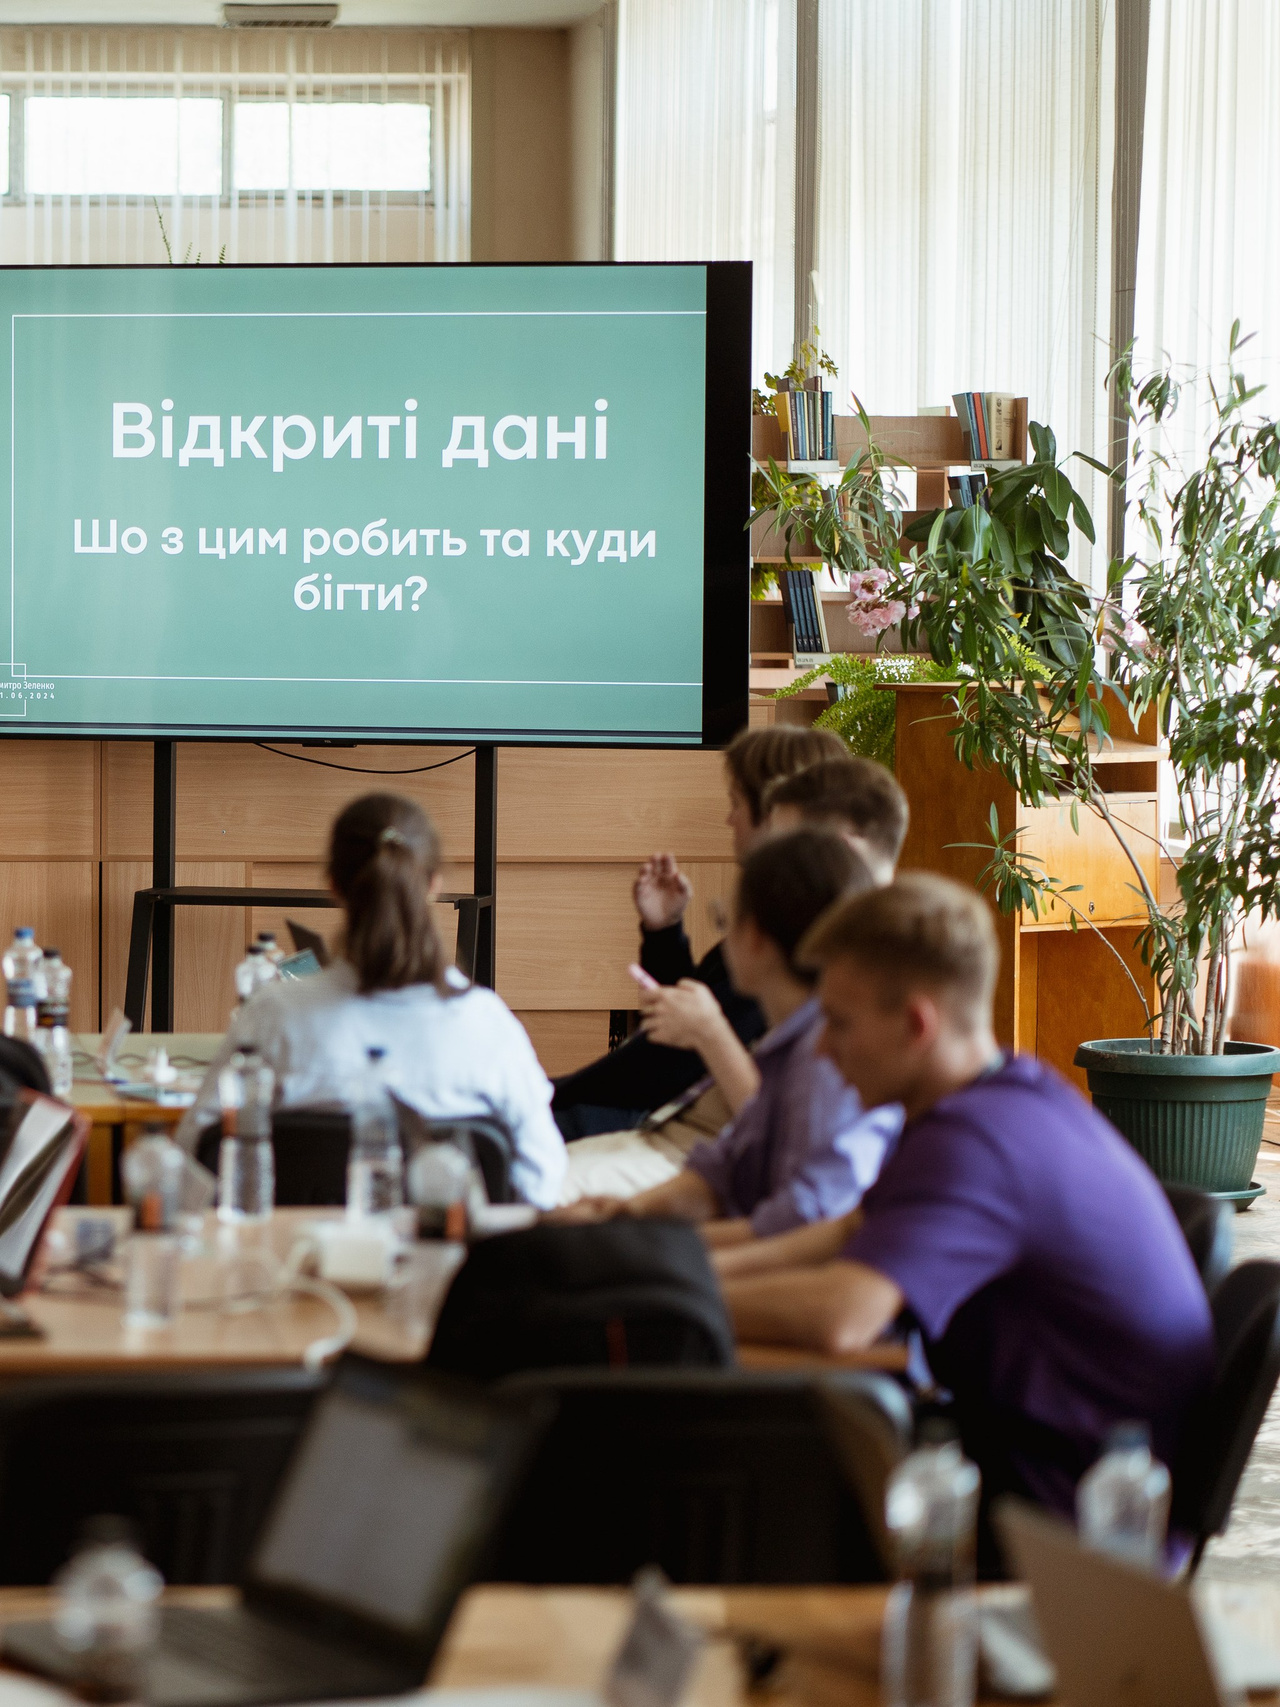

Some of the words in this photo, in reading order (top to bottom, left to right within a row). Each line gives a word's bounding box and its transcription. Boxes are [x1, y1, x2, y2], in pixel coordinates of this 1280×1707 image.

[110, 397, 418, 473] Відкриті
[441, 397, 609, 469] дані
[72, 517, 148, 555] Шо
[160, 526, 184, 556] з
[197, 526, 287, 561] цим
[302, 517, 468, 565] робить
[479, 527, 531, 558] та
[546, 529, 657, 566] куди
[293, 573, 429, 613] бігти?
[23, 681, 55, 690] Зеленко
